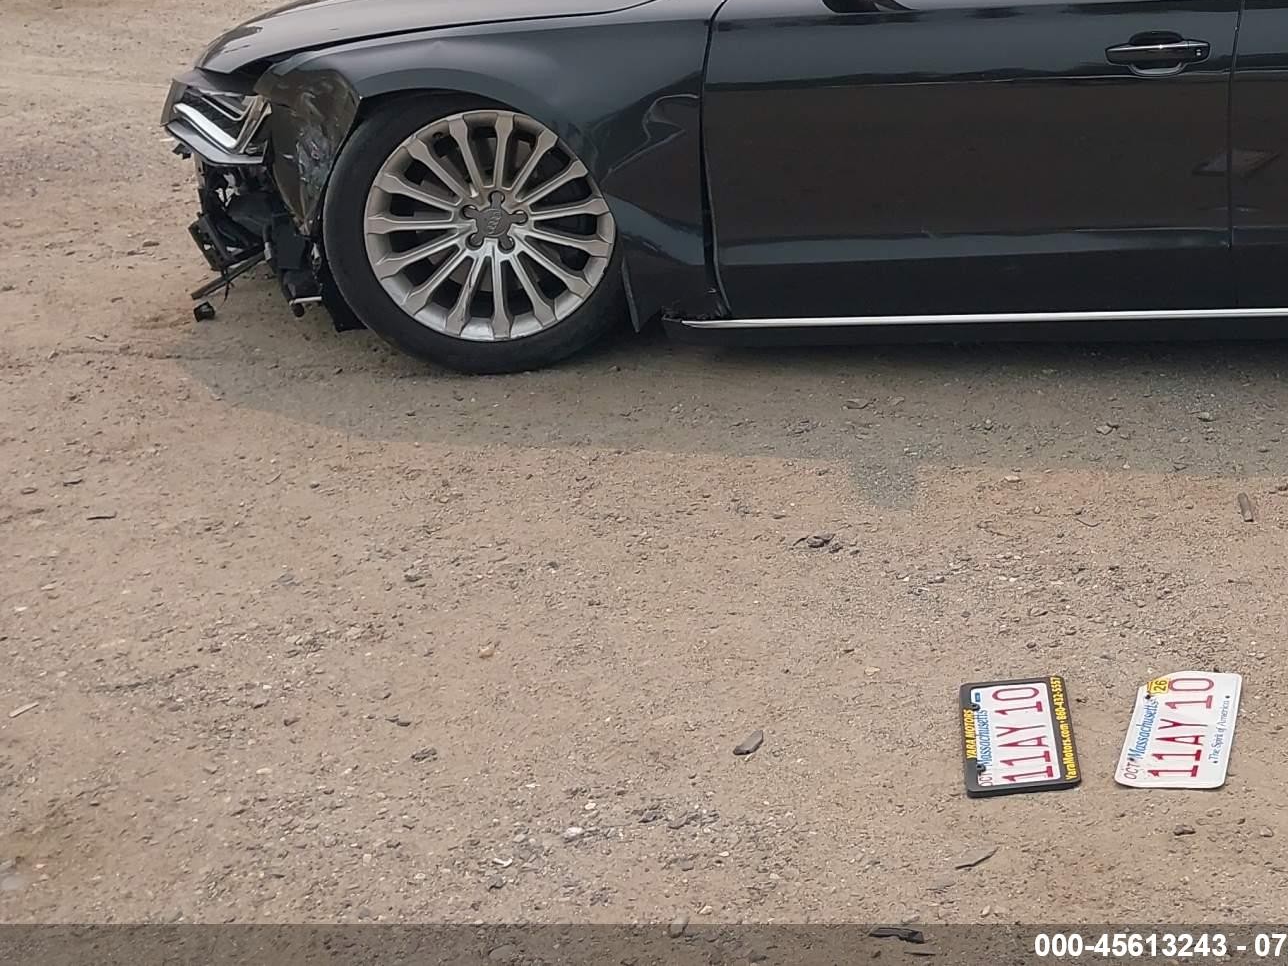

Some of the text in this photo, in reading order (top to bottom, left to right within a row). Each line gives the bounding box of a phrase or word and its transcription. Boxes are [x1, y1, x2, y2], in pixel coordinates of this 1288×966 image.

[1153, 680, 1167, 691] 26
[963, 709, 977, 759] YARA MOTORS
[992, 687, 1053, 781] 11AY 10
[1128, 698, 1159, 759] Massachusetts
[1147, 677, 1214, 777] 11AY 10
[1217, 700, 1230, 726] America
[975, 710, 993, 767] Massachusetts
[1059, 723, 1077, 780] YaraMotors.com
[1208, 749, 1221, 760] The
[1211, 733, 1224, 748] Spirit
[1124, 762, 1141, 779] OCT
